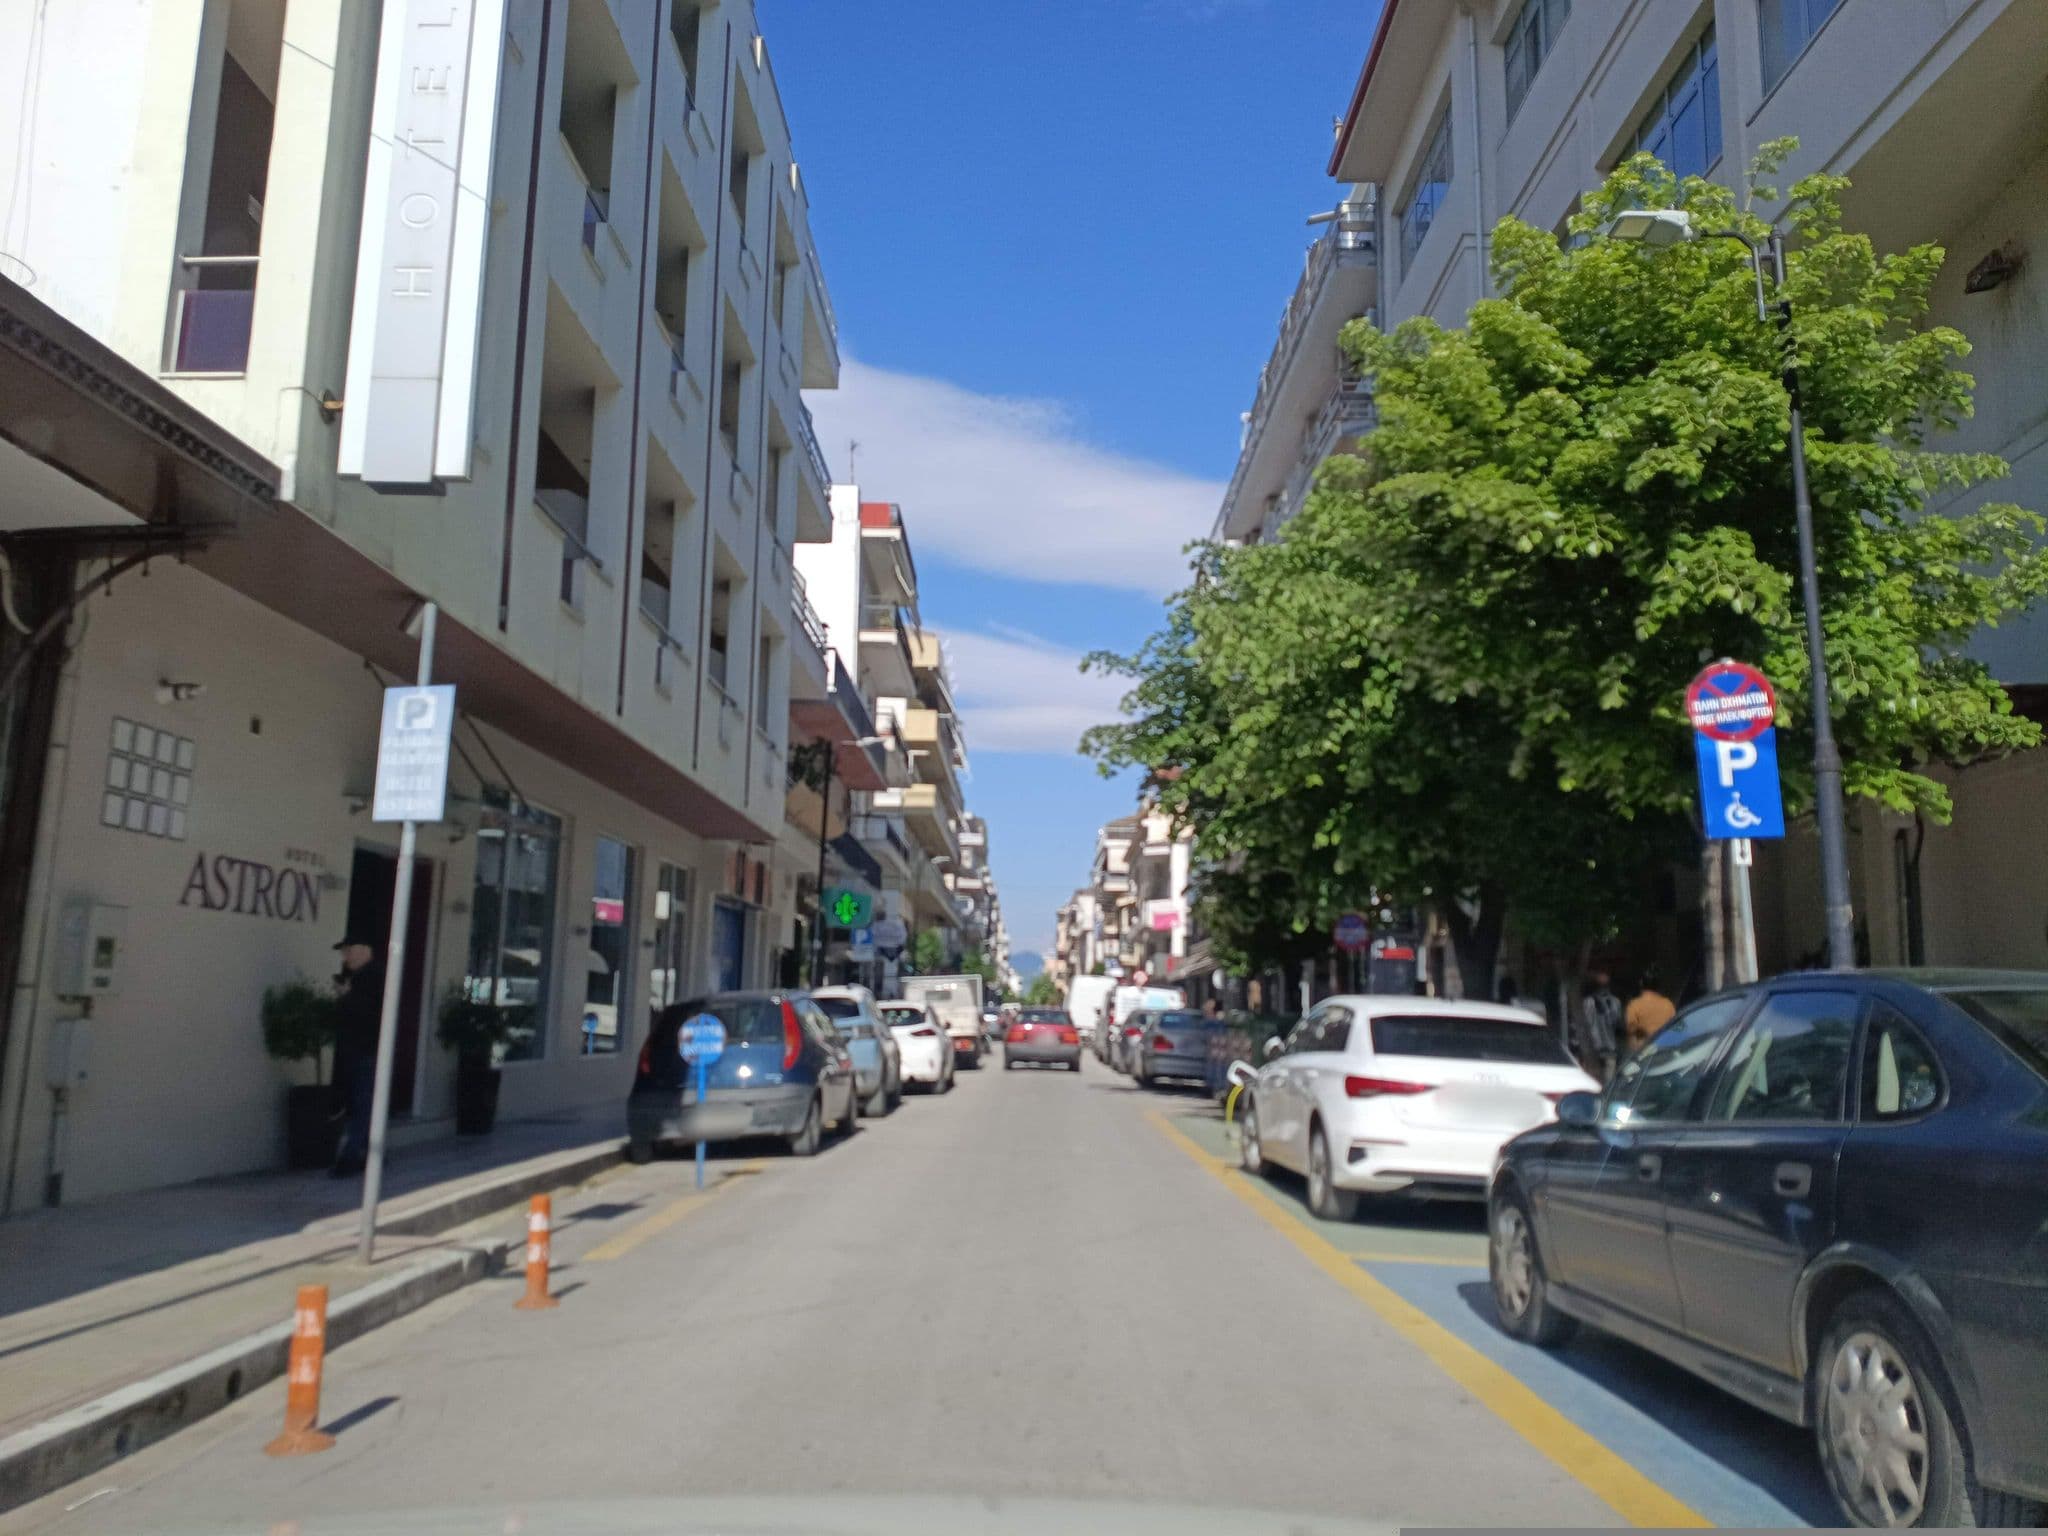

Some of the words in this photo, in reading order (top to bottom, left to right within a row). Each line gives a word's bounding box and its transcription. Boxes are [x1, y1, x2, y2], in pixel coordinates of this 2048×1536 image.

[391, 7, 458, 298] HOTEL
[403, 697, 429, 729] P
[1695, 698, 1719, 712] ΠΛΗΝ
[1721, 691, 1768, 707] ΟΧΗΜΑΤΩΝ
[1717, 741, 1757, 787] P
[177, 851, 321, 922] ASTRON
